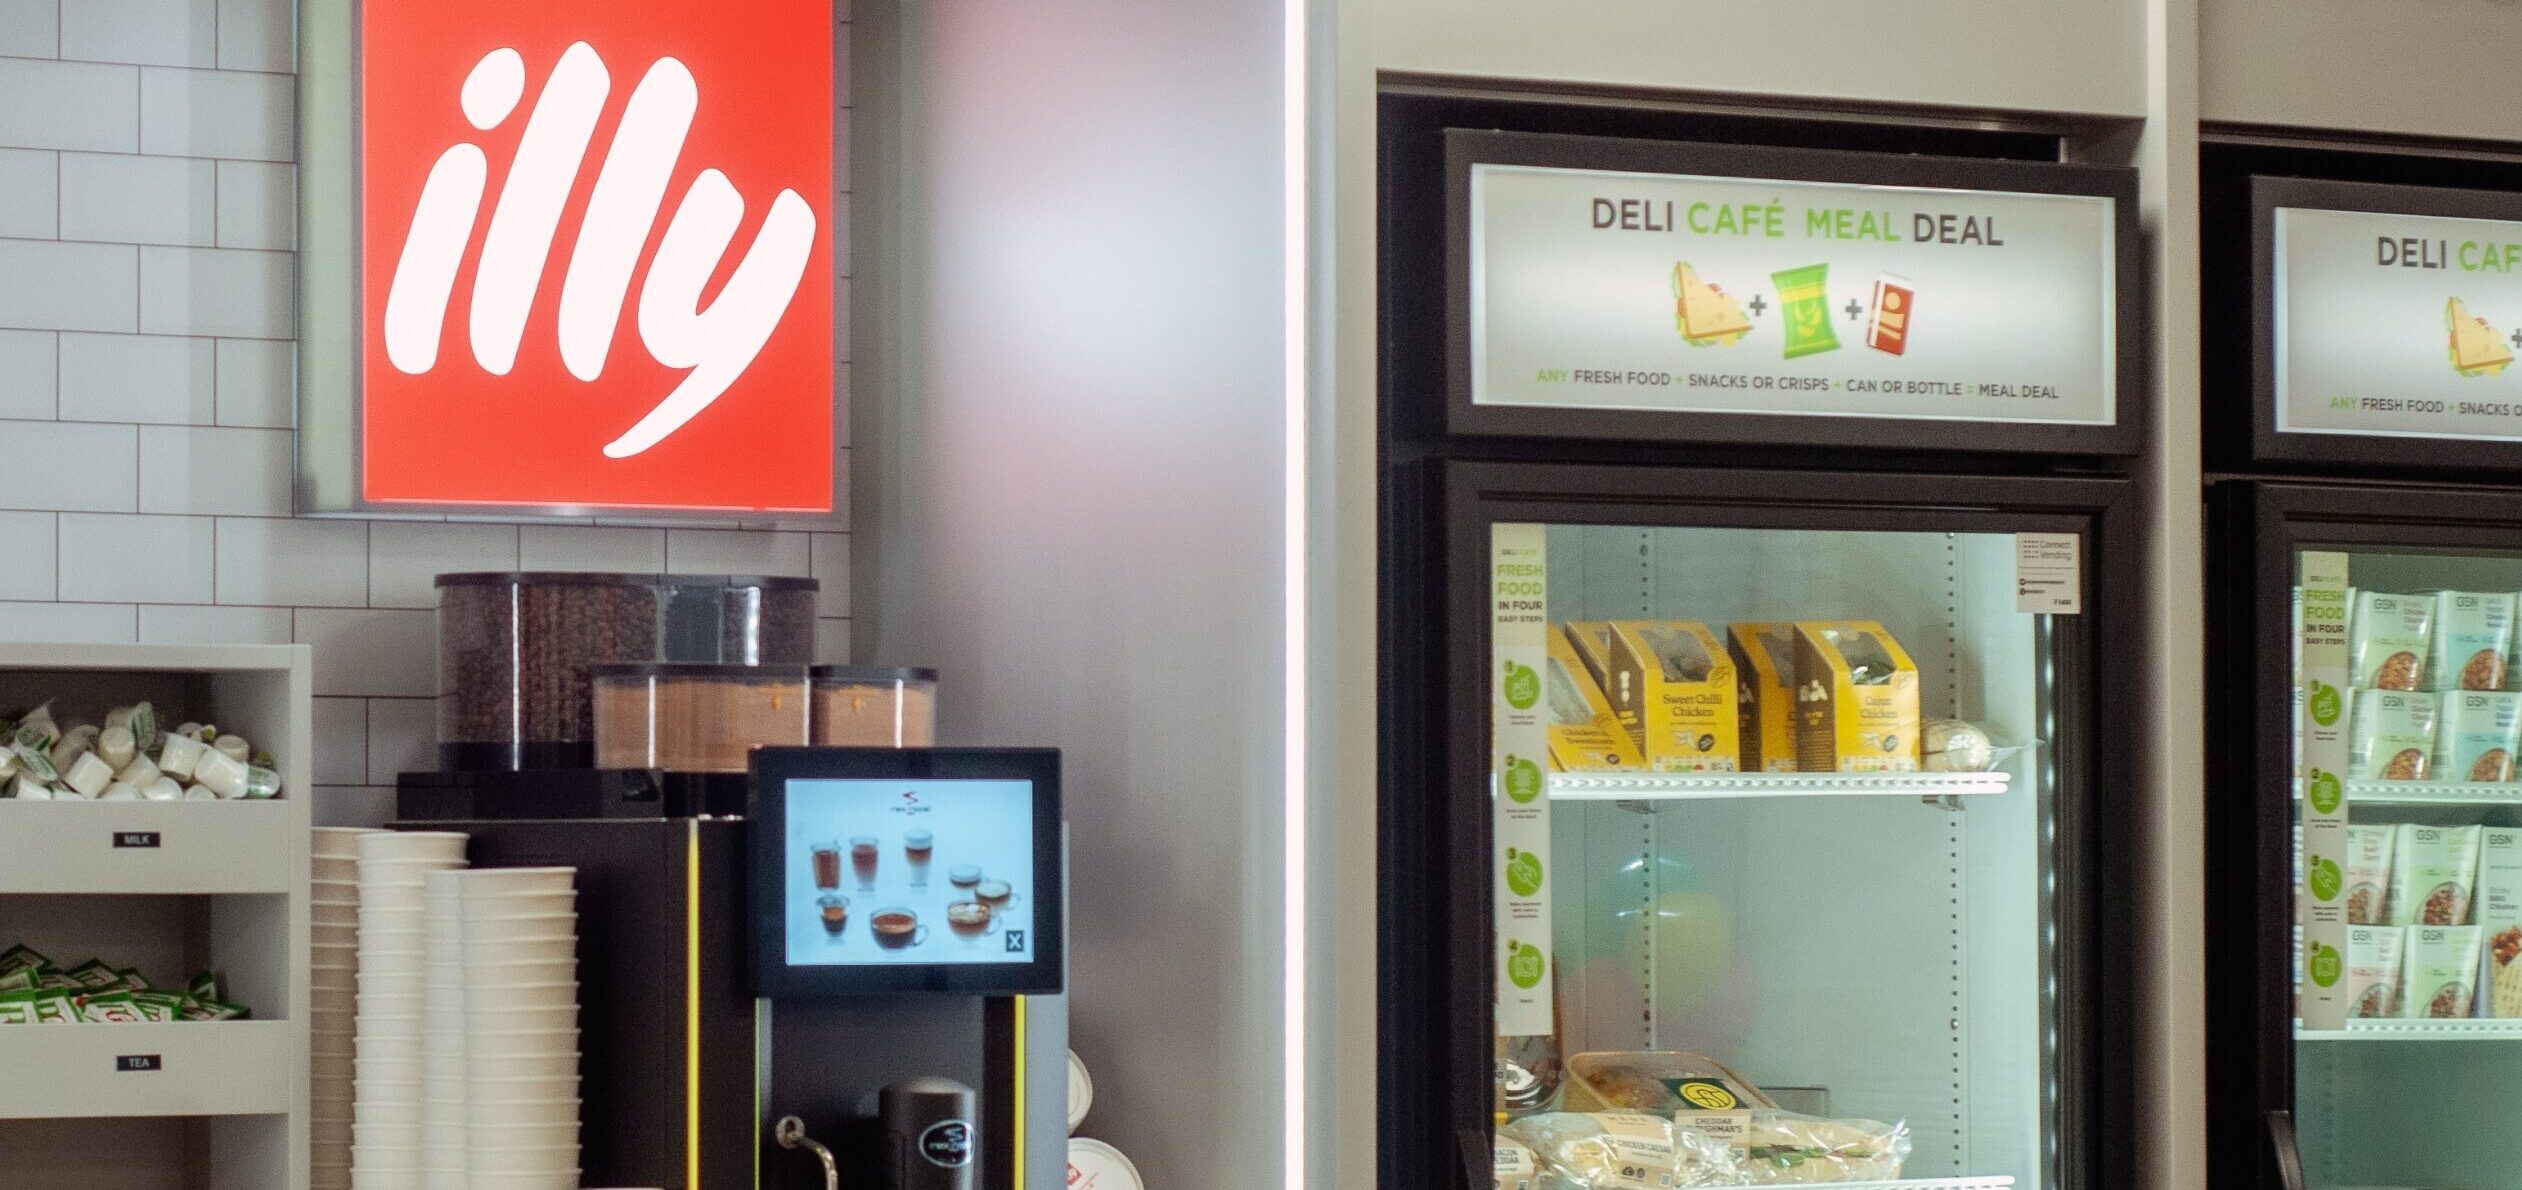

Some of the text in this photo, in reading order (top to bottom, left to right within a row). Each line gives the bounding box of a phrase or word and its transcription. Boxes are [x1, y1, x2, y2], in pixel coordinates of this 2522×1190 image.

[1592, 197, 2005, 247] DELI CAFÉ MEAL DEAL
[384, 40, 817, 459] illy
[2377, 236, 2447, 269] DELI
[1536, 368, 1569, 383] ANY
[1574, 369, 1623, 385] FRESH
[1628, 371, 1671, 386] FOOD
[1688, 373, 1748, 389] SNACKS
[1753, 375, 1775, 390] OR
[1779, 376, 1830, 392] CRISPS
[1846, 378, 1878, 393] CAN
[1882, 379, 1903, 394] OR
[1907, 380, 1962, 396] BOTTLE
[1979, 382, 2017, 398] MEAL
[2022, 384, 2059, 399] DEAL
[2330, 395, 2357, 410] ANY
[2361, 397, 2403, 412] FRESH
[2407, 399, 2445, 413] FOOD
[2458, 400, 2510, 417] SNACKS
[1497, 563, 1543, 577] FRESH
[1497, 581, 1543, 596] FOOD
[2306, 589, 2345, 602] FRESH
[1498, 600, 1543, 611] IN FOUR
[2306, 606, 2345, 619] FOOD
[1498, 615, 1543, 623] EASY STEPS
[2306, 623, 2345, 633] IN FOUR
[2306, 637, 2323, 645] EASY
[1663, 693, 1723, 705] Sweet Chilli
[1673, 706, 1714, 717] Chicken
[124, 834, 150, 845] MILK
[2489, 833, 2512, 845] GSN
[128, 1057, 150, 1068] TEA
